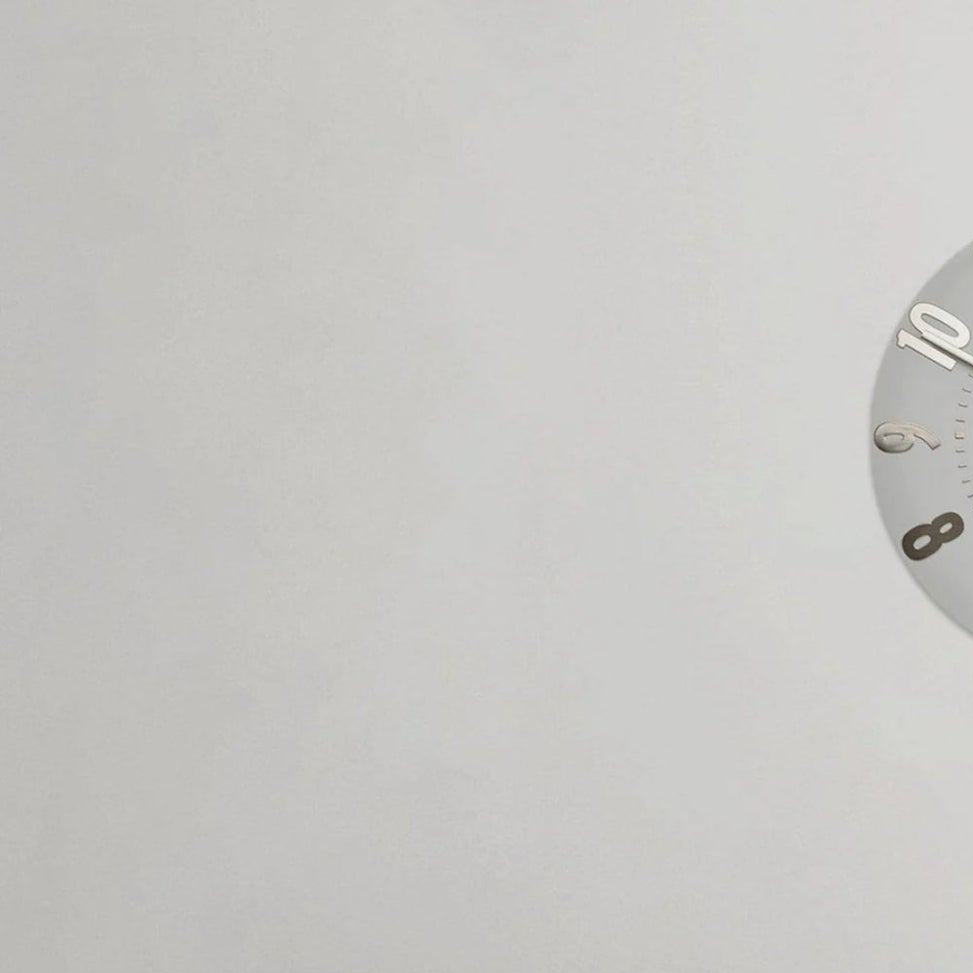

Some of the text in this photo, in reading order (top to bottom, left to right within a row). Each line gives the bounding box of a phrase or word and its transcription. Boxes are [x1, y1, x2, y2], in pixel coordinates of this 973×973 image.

[896, 303, 972, 370] 10
[873, 422, 941, 454] 9
[901, 511, 965, 561] 8
